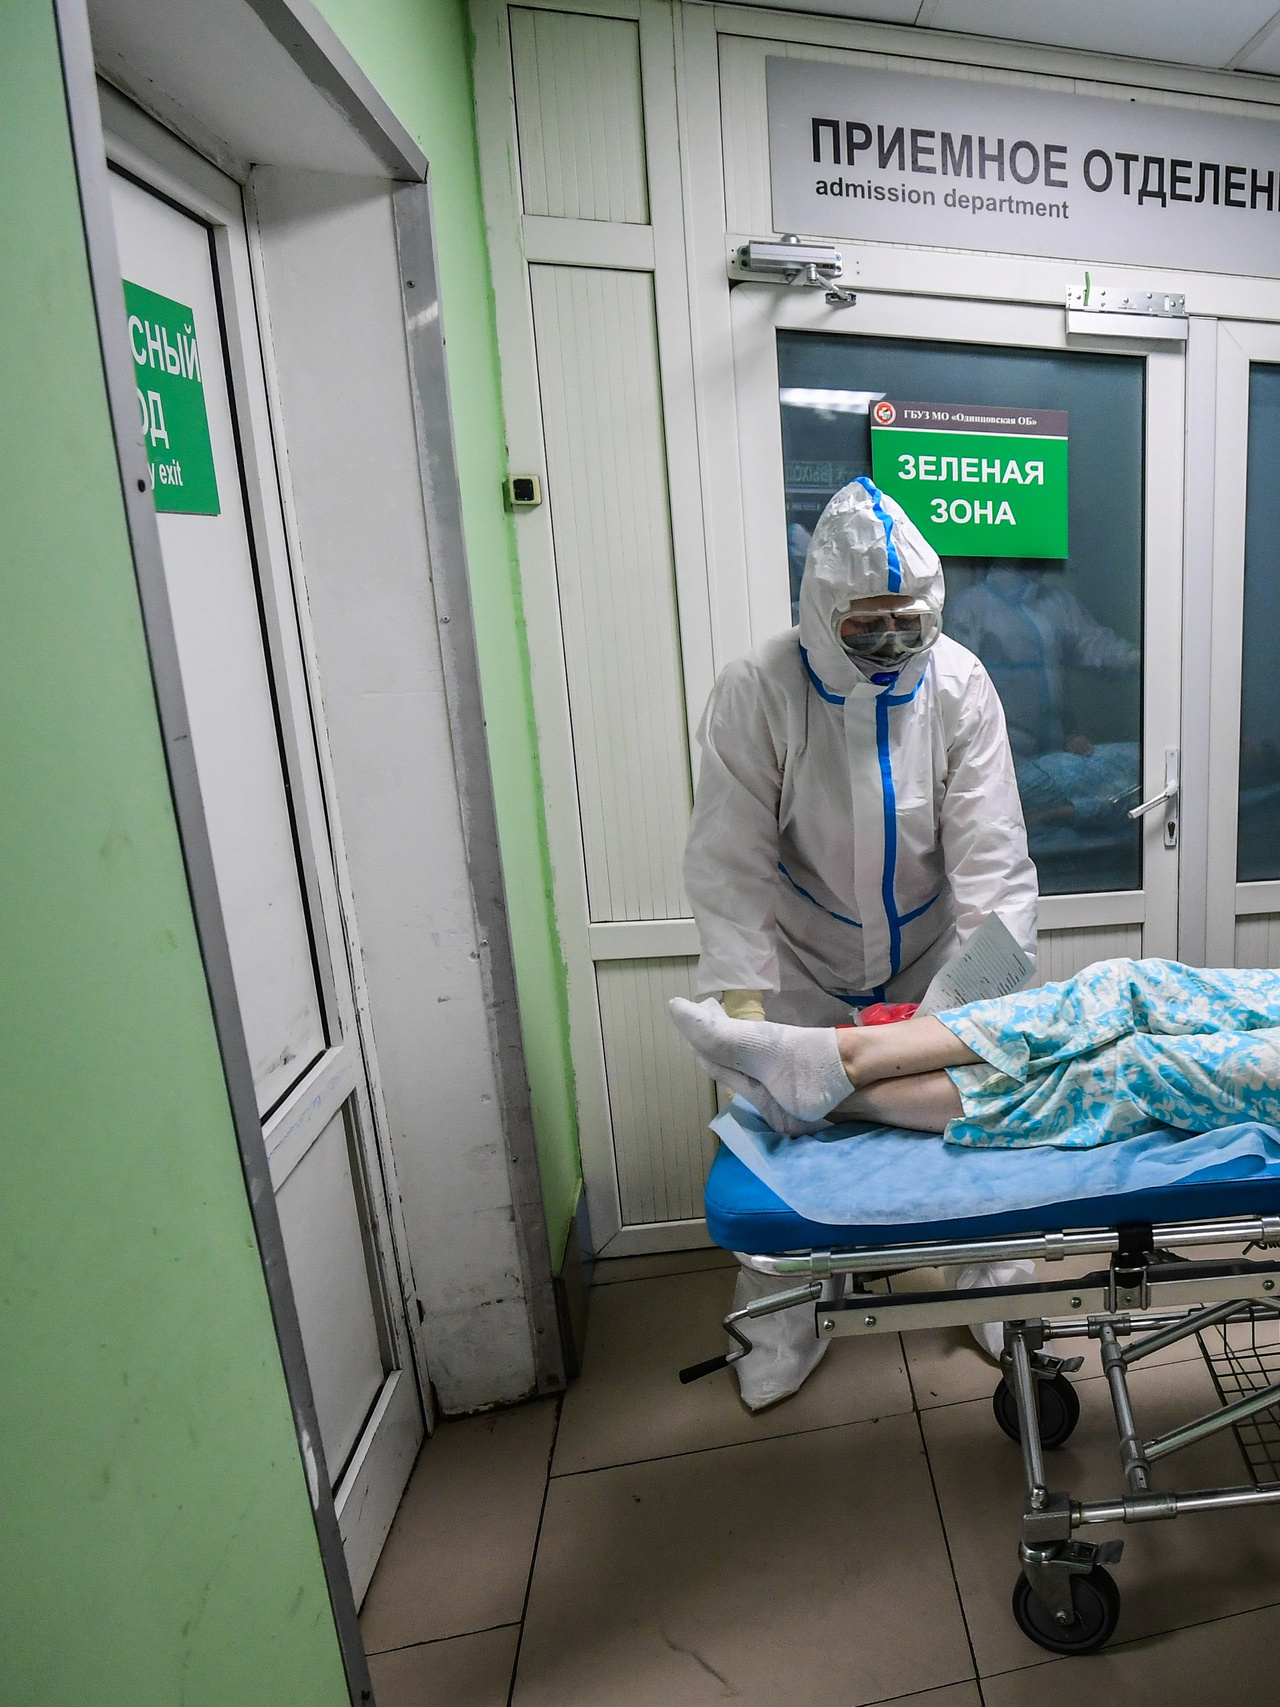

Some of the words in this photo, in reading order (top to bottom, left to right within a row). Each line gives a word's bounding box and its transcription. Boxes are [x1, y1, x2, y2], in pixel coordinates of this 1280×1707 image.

[810, 117, 1069, 189] ПРИЕМНОЕ
[815, 177, 936, 206] admission
[943, 186, 1070, 221] department
[128, 314, 203, 383] СНЫЙ
[903, 409, 930, 420] ГБУЗ
[932, 412, 950, 421] МО
[159, 459, 183, 487] exit
[897, 454, 1045, 485] ЗЕЛЕНАЯ
[930, 498, 1017, 526] ЗОНА
